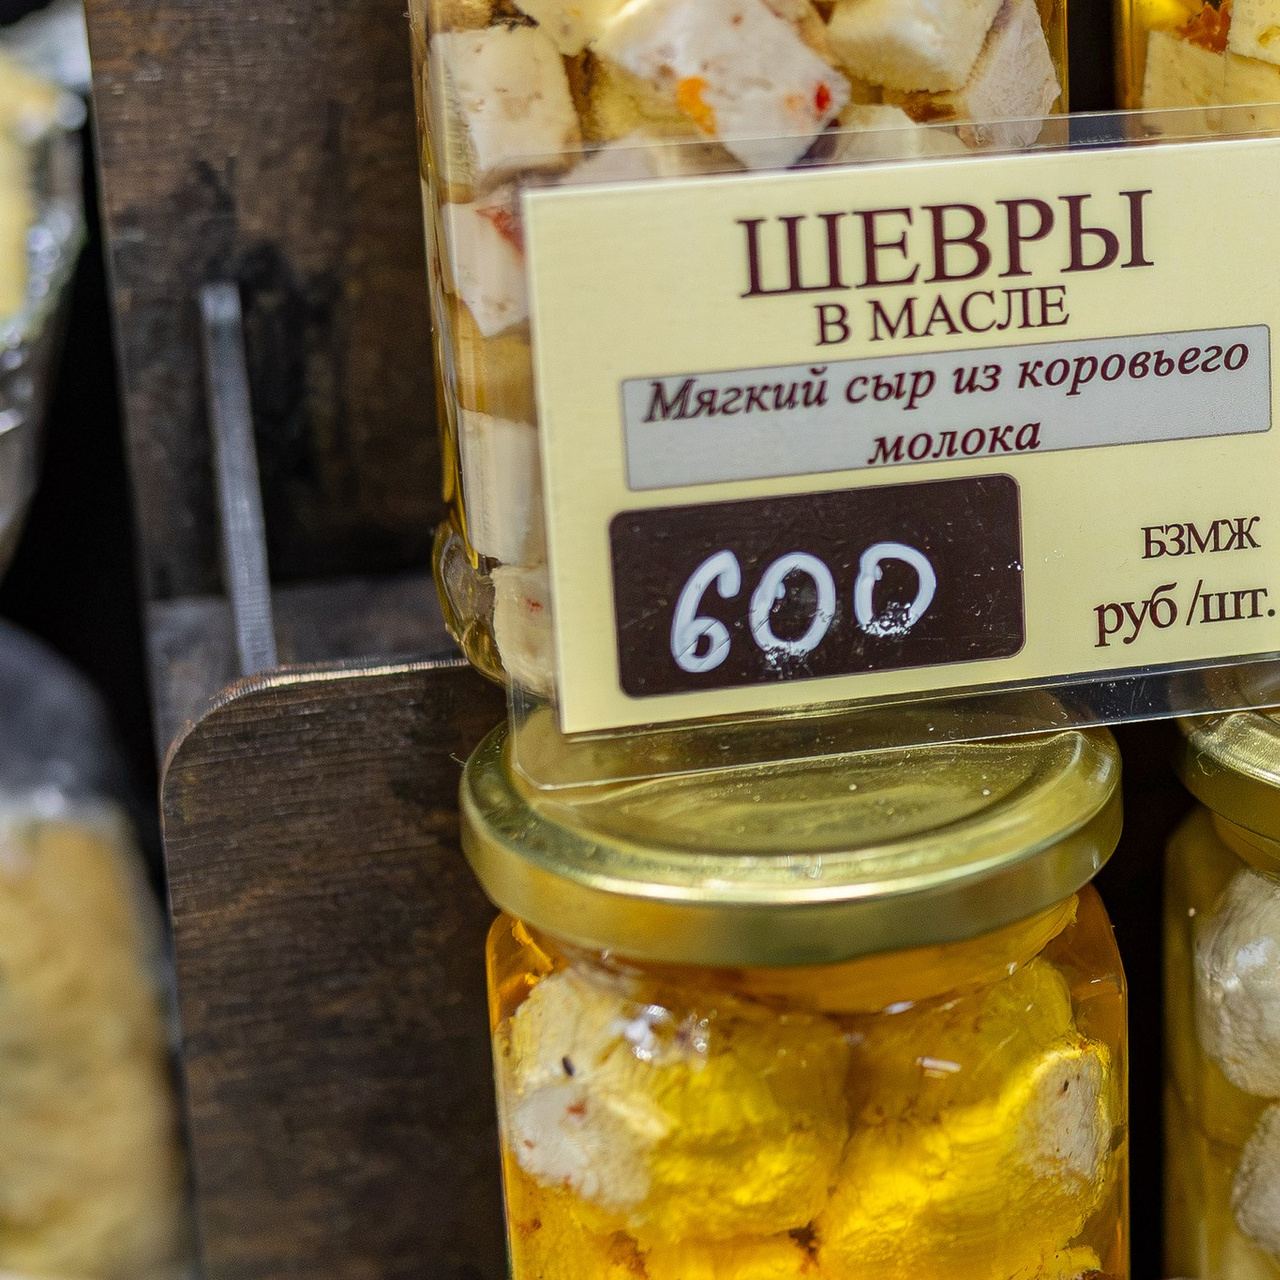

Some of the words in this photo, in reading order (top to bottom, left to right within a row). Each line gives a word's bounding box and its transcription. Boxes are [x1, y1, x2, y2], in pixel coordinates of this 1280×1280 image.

[737, 189, 1156, 300] ШЕВРЫ
[815, 303, 852, 347] В
[868, 285, 1071, 343] МАСЛЕ
[643, 367, 831, 424] Мягкий
[844, 362, 937, 413] сыр
[951, 360, 1001, 396] из
[1018, 339, 1251, 398] коровьего
[867, 418, 1042, 466] молока
[1141, 516, 1261, 559] БЗМЖ
[671, 541, 938, 674] 600
